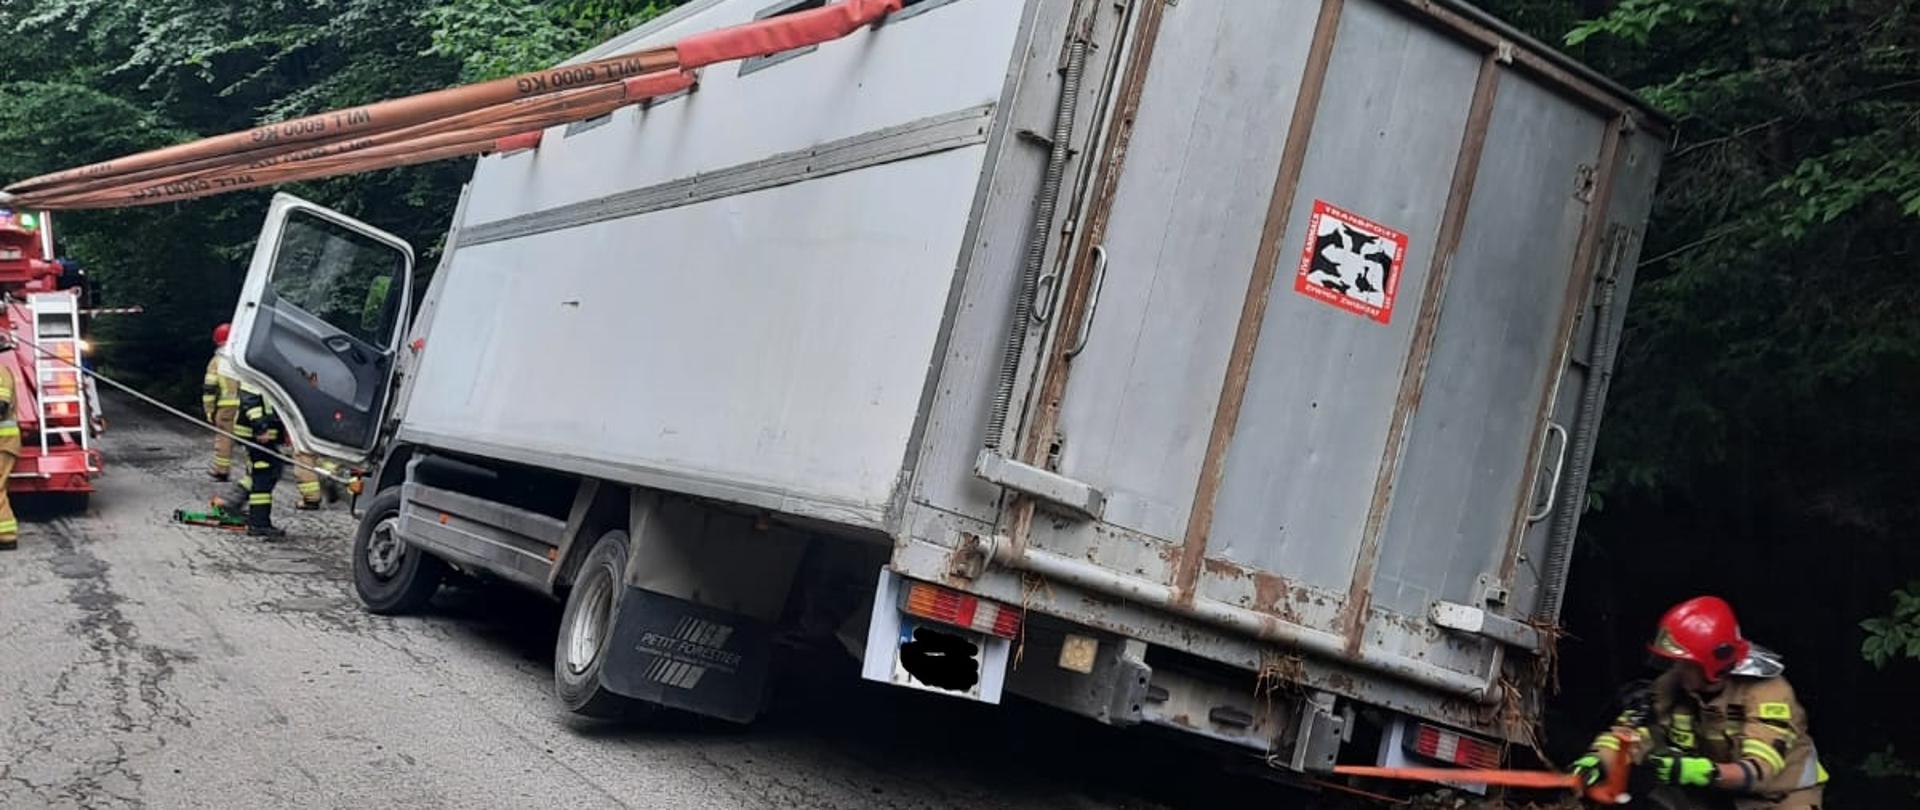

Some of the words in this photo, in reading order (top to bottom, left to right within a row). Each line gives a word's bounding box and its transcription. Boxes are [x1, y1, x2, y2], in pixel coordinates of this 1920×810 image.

[551, 67, 596, 87] 6000
[598, 58, 642, 78] WLL
[517, 75, 546, 93] KG
[1324, 205, 1399, 239] TRANSPORT
[1299, 256, 1310, 276] LIVE
[1306, 213, 1320, 252] ANIMALS
[641, 632, 676, 649] PETIT
[679, 641, 742, 665] FORESTIER
